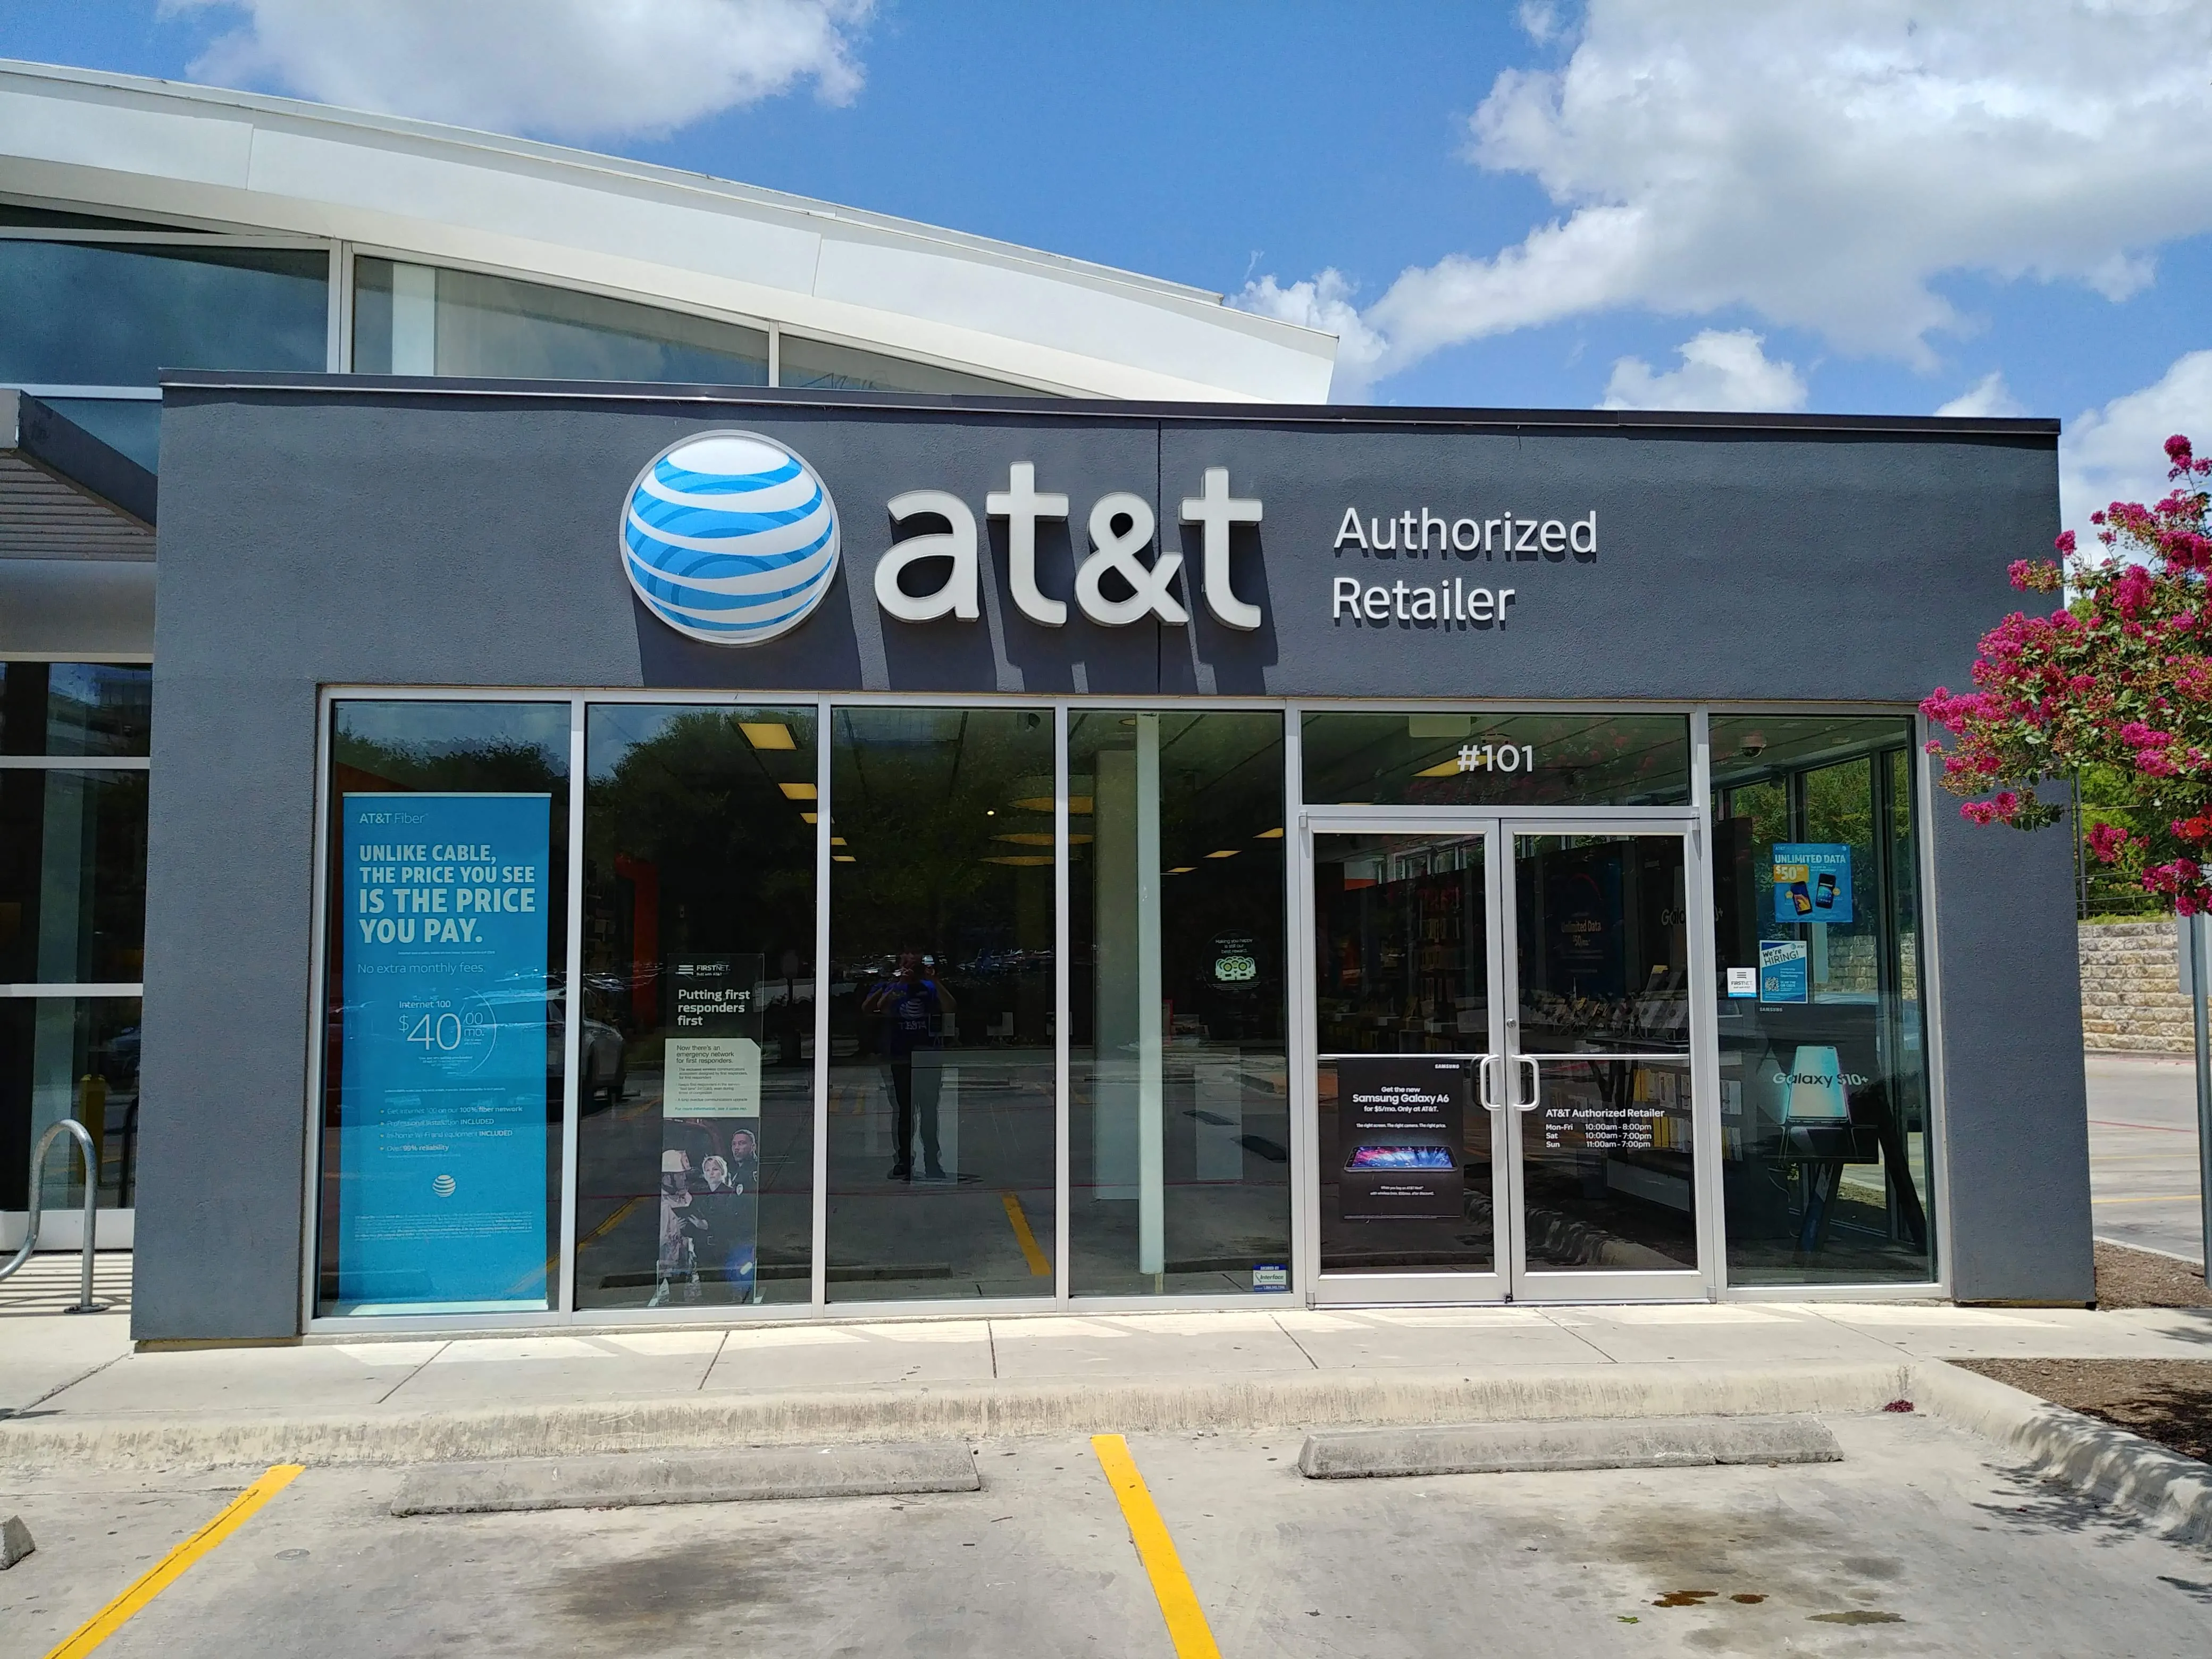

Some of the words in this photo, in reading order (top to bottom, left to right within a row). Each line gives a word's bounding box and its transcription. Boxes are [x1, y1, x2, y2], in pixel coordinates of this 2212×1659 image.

[1334, 507, 1596, 554] Authorized
[874, 461, 1264, 631] at&t
[1334, 578, 1514, 622] Retailer
[1457, 744, 1533, 773] #101
[359, 814, 392, 824] AT&T
[395, 813, 424, 824] Fiber
[360, 845, 426, 861] UNLIKE
[432, 845, 496, 864] CABLE,
[1775, 854, 1822, 864] UNLIMITED
[1824, 855, 1846, 864] DATA
[360, 867, 396, 883] THE
[401, 867, 454, 883] PRICE
[460, 867, 497, 883] YOU
[502, 866, 534, 883] SEE
[359, 889, 384, 913] IS
[392, 889, 447, 913] THE
[457, 888, 535, 912] PRICE
[359, 918, 415, 943] YOU
[425, 918, 482, 943] PAY.
[1588, 920, 1602, 932] Data
[1763, 949, 1782, 958] We're
[1764, 950, 1799, 966] HIRING!
[358, 964, 374, 974] No
[377, 964, 406, 973] extra
[409, 962, 456, 975] monthly
[459, 962, 485, 973] fees.
[678, 990, 722, 1001] Putting
[725, 990, 750, 1000] first
[678, 1002, 745, 1015] responders
[677, 1016, 703, 1026] first
[1773, 1072, 1833, 1088] Galaxy
[1837, 1073, 1869, 1086] S10+
[1353, 1094, 1399, 1104] Samsung
[1401, 1094, 1436, 1104] Galaxy
[1572, 1109, 1626, 1117] Authorized
